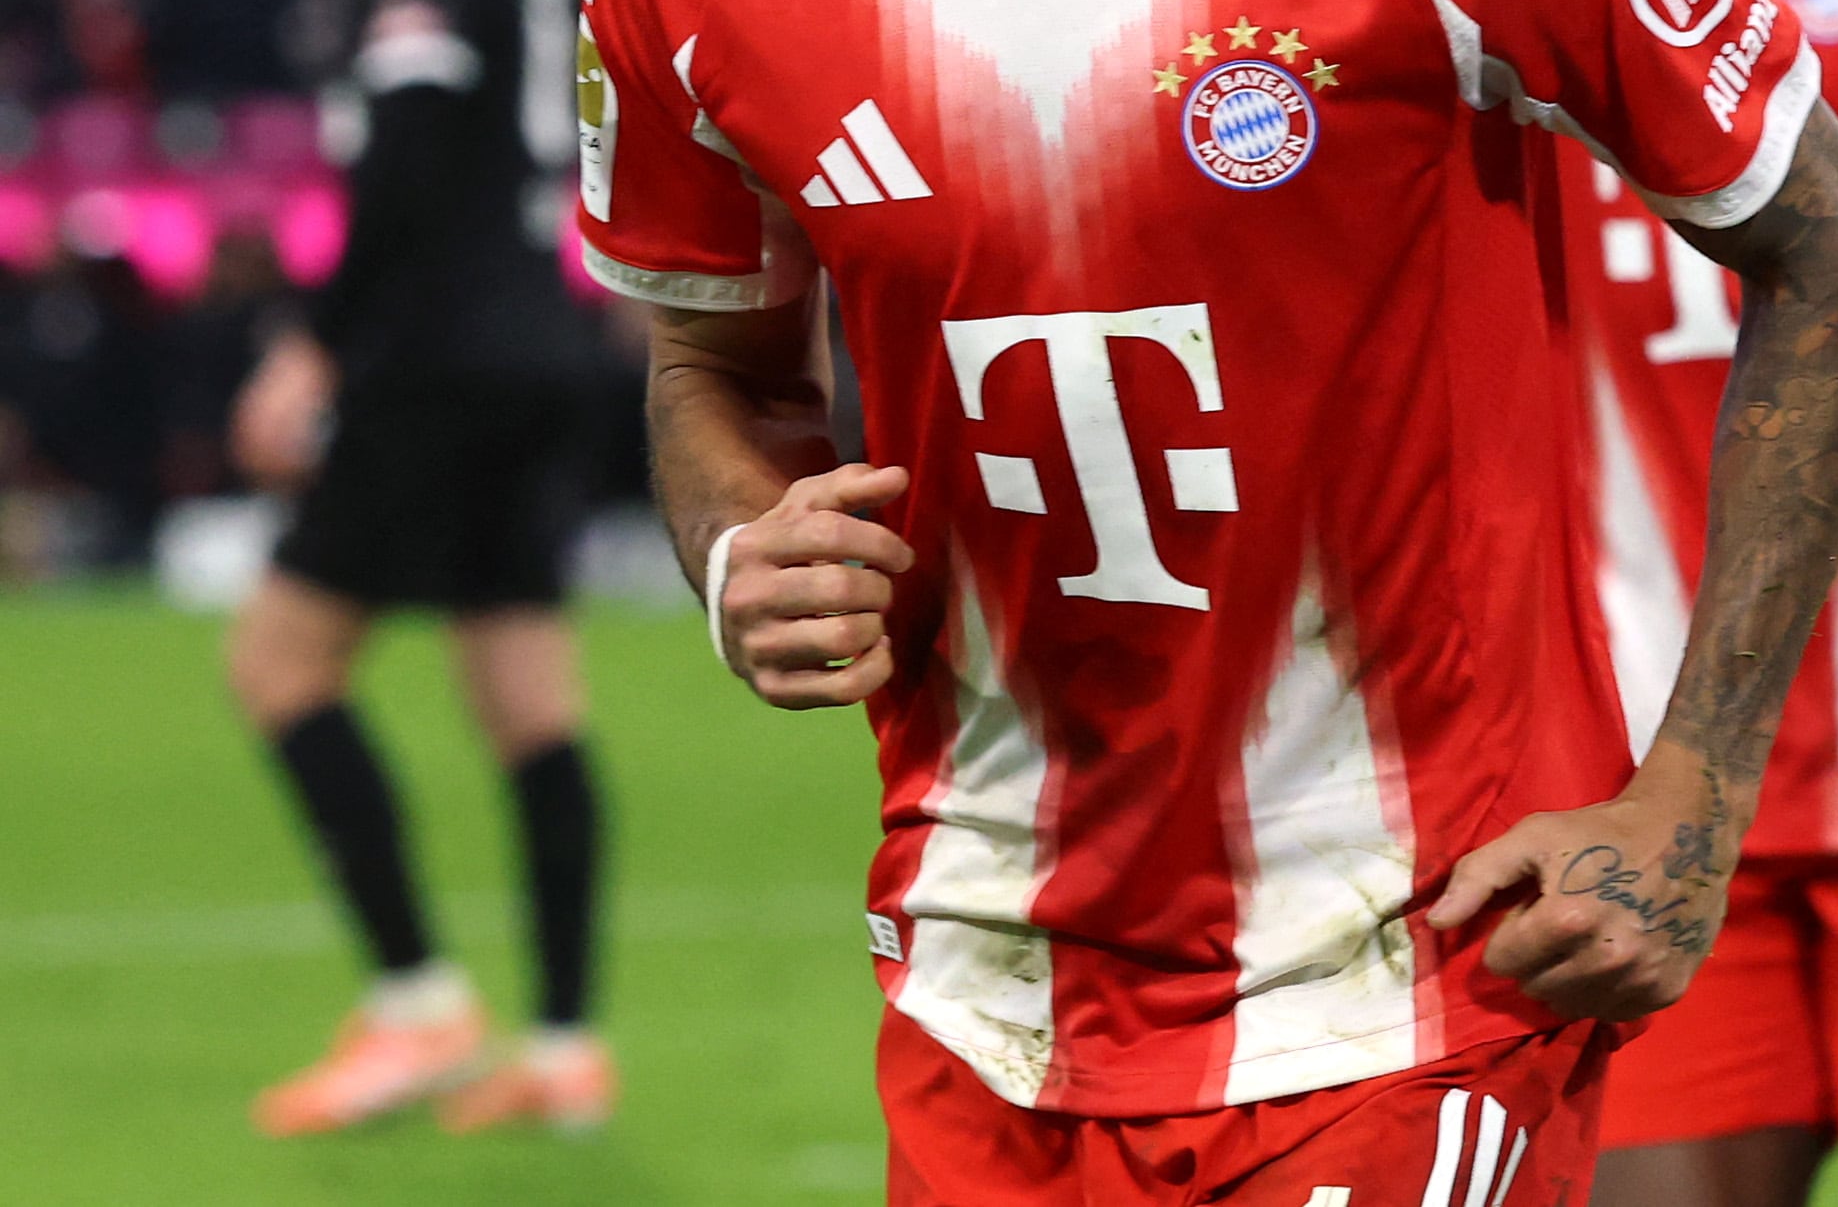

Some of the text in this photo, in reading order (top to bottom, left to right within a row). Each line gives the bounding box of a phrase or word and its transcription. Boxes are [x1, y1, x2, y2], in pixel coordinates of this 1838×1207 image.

[1192, 69, 1305, 119] FC BAYERN
[940, 301, 1240, 612] T
